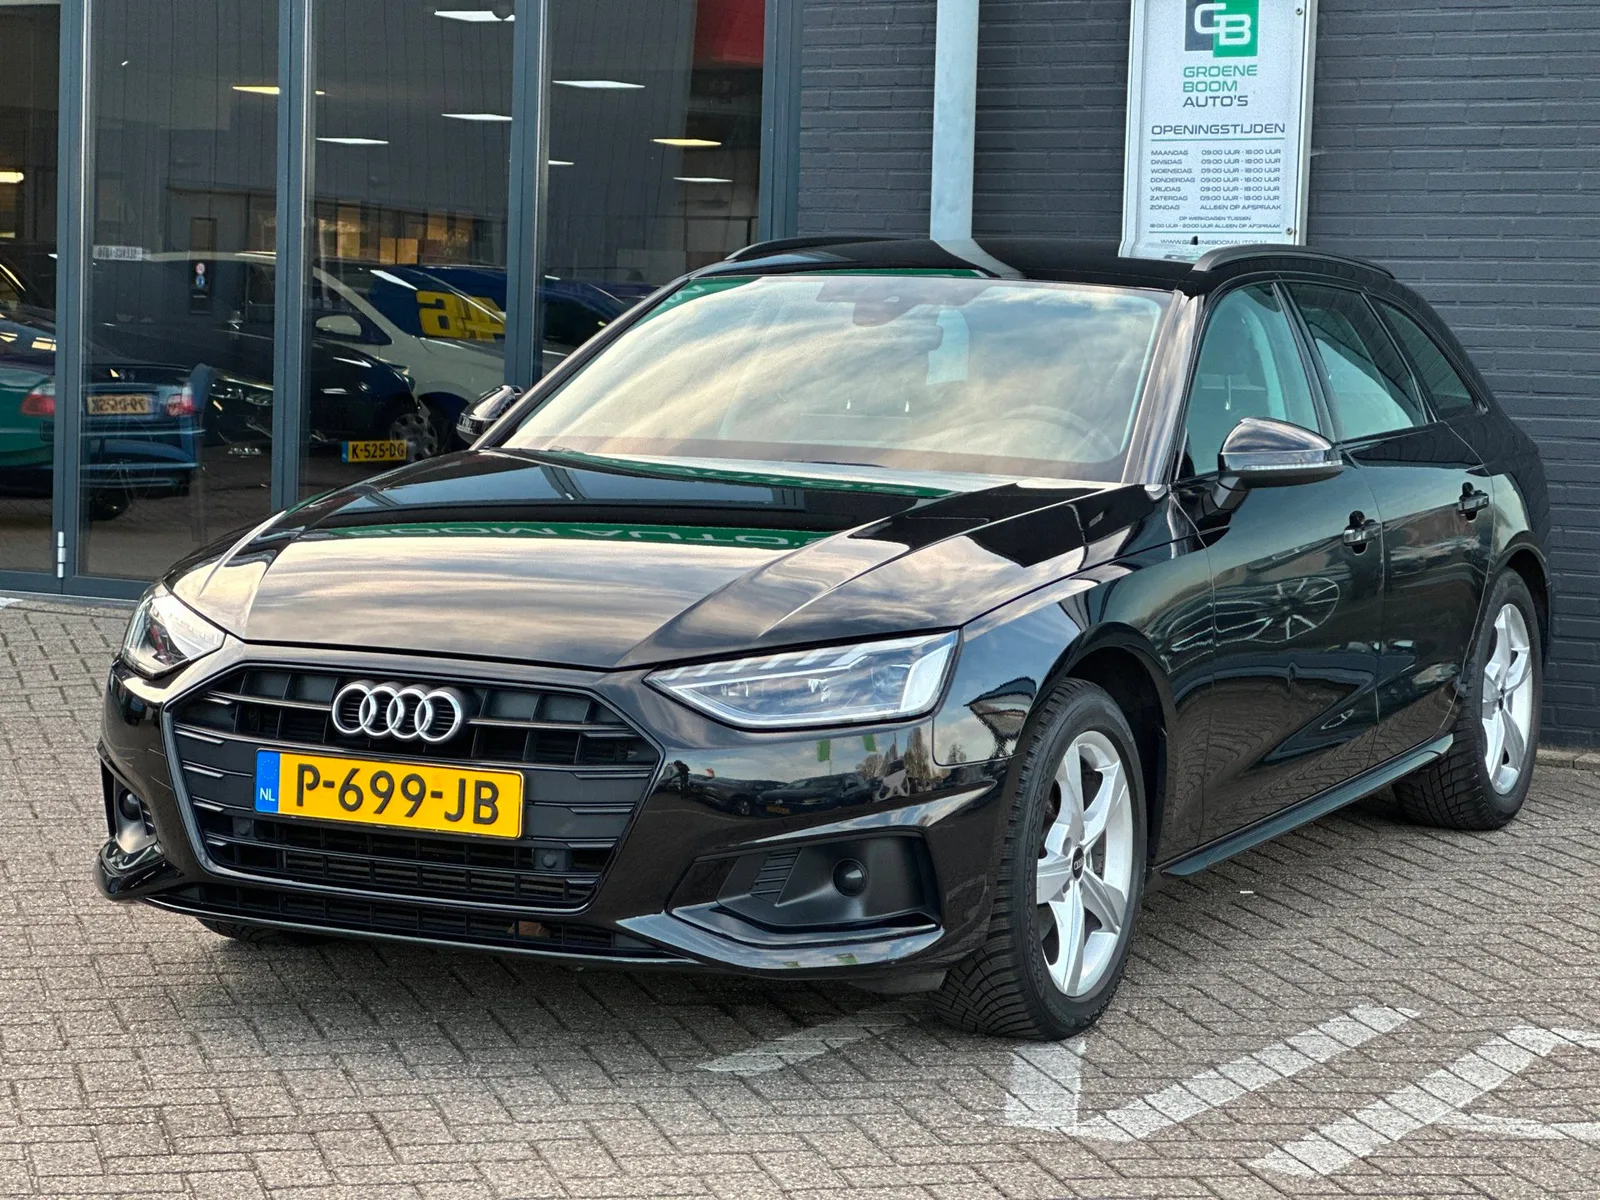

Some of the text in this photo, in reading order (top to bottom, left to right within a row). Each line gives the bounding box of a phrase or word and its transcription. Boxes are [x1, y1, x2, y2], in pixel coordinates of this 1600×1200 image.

[1183, 65, 1258, 78] GROENE
[1182, 80, 1238, 93] BOOM
[1182, 95, 1249, 108] AUTO'S
[1151, 123, 1286, 135] OPENINGSTIJDEN
[352, 442, 405, 459] K-525-DG
[259, 762, 500, 825] NL P-699-JB
